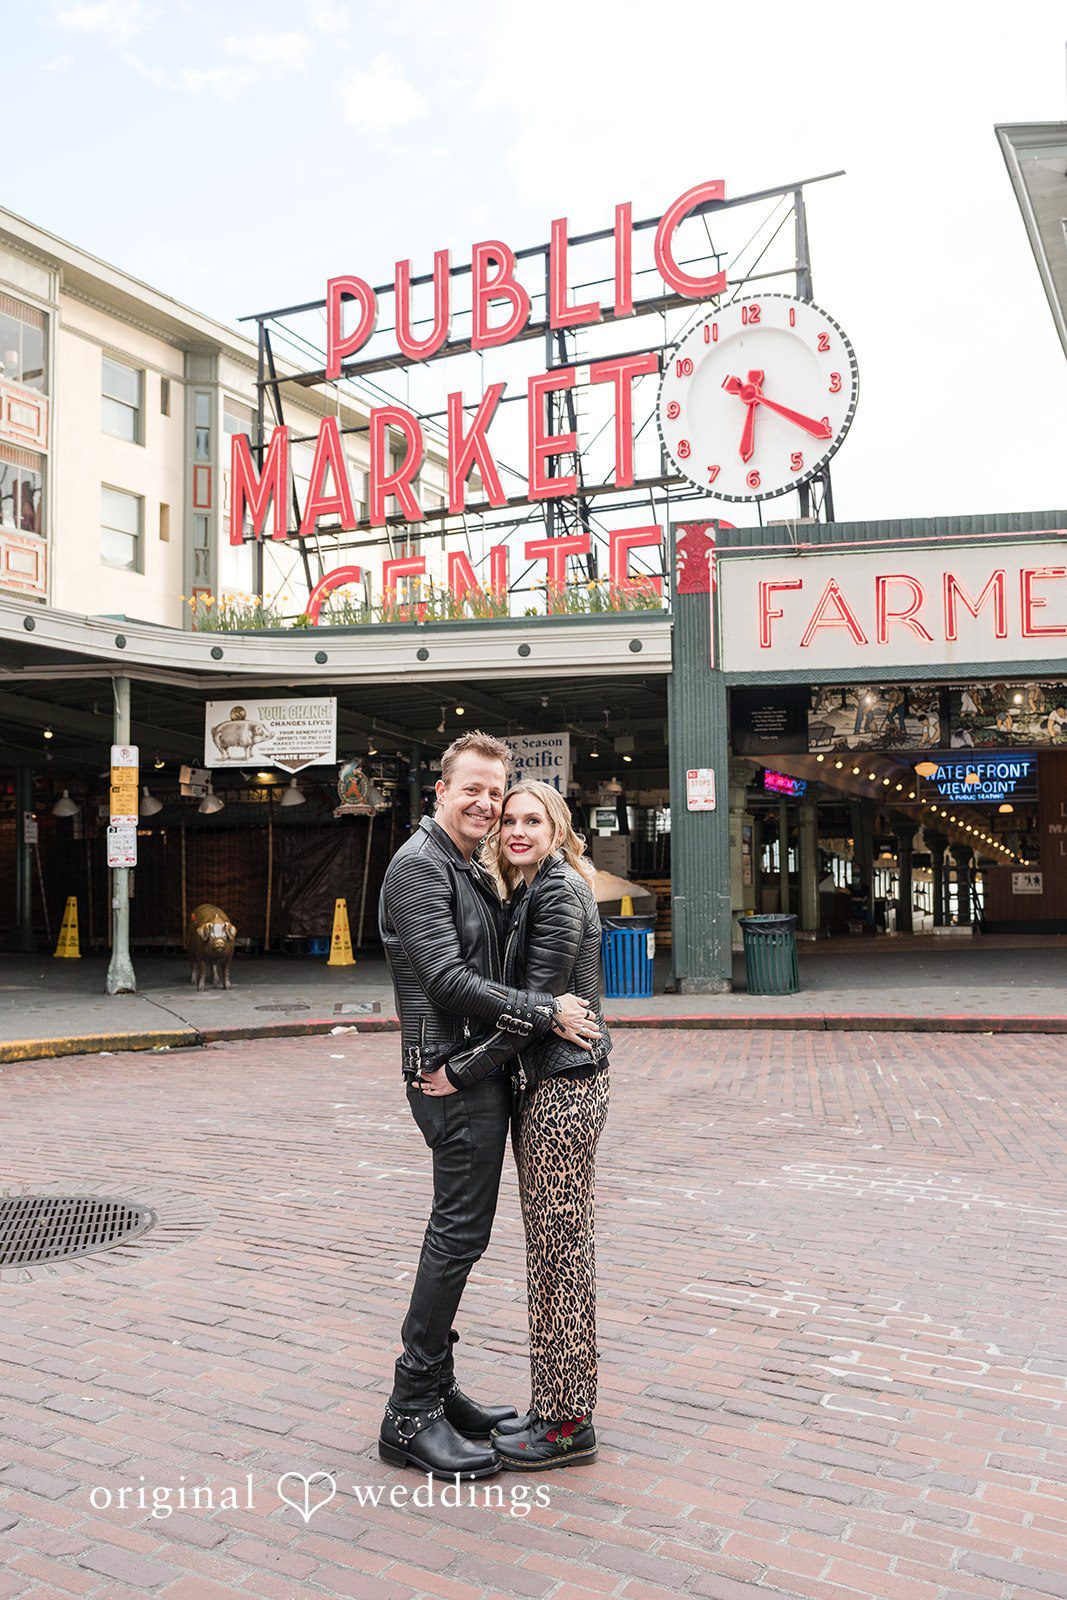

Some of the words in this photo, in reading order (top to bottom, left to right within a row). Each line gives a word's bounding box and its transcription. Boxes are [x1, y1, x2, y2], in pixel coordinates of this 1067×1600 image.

[324, 179, 728, 380] PUBLIC
[742, 304, 761, 325] 12
[789, 308, 796, 328] 1
[703, 323, 718, 344] 11
[817, 332, 831, 352] 2
[676, 358, 694, 378] 10
[829, 372, 842, 393] 3
[667, 401, 681, 420] 9
[229, 352, 662, 547] MARKET
[677, 440, 691, 459] 8
[790, 452, 804, 472] 5
[707, 465, 721, 484] 7
[746, 470, 761, 488] 6
[303, 519, 738, 627] CENTE
[758, 567, 1067, 649] FARME
[258, 706, 287, 721] YOUR
[289, 704, 333, 720] CHANGE
[521, 738, 563, 749] Season
[511, 750, 563, 768] acific
[937, 781, 1017, 796] VIEWPOINT
